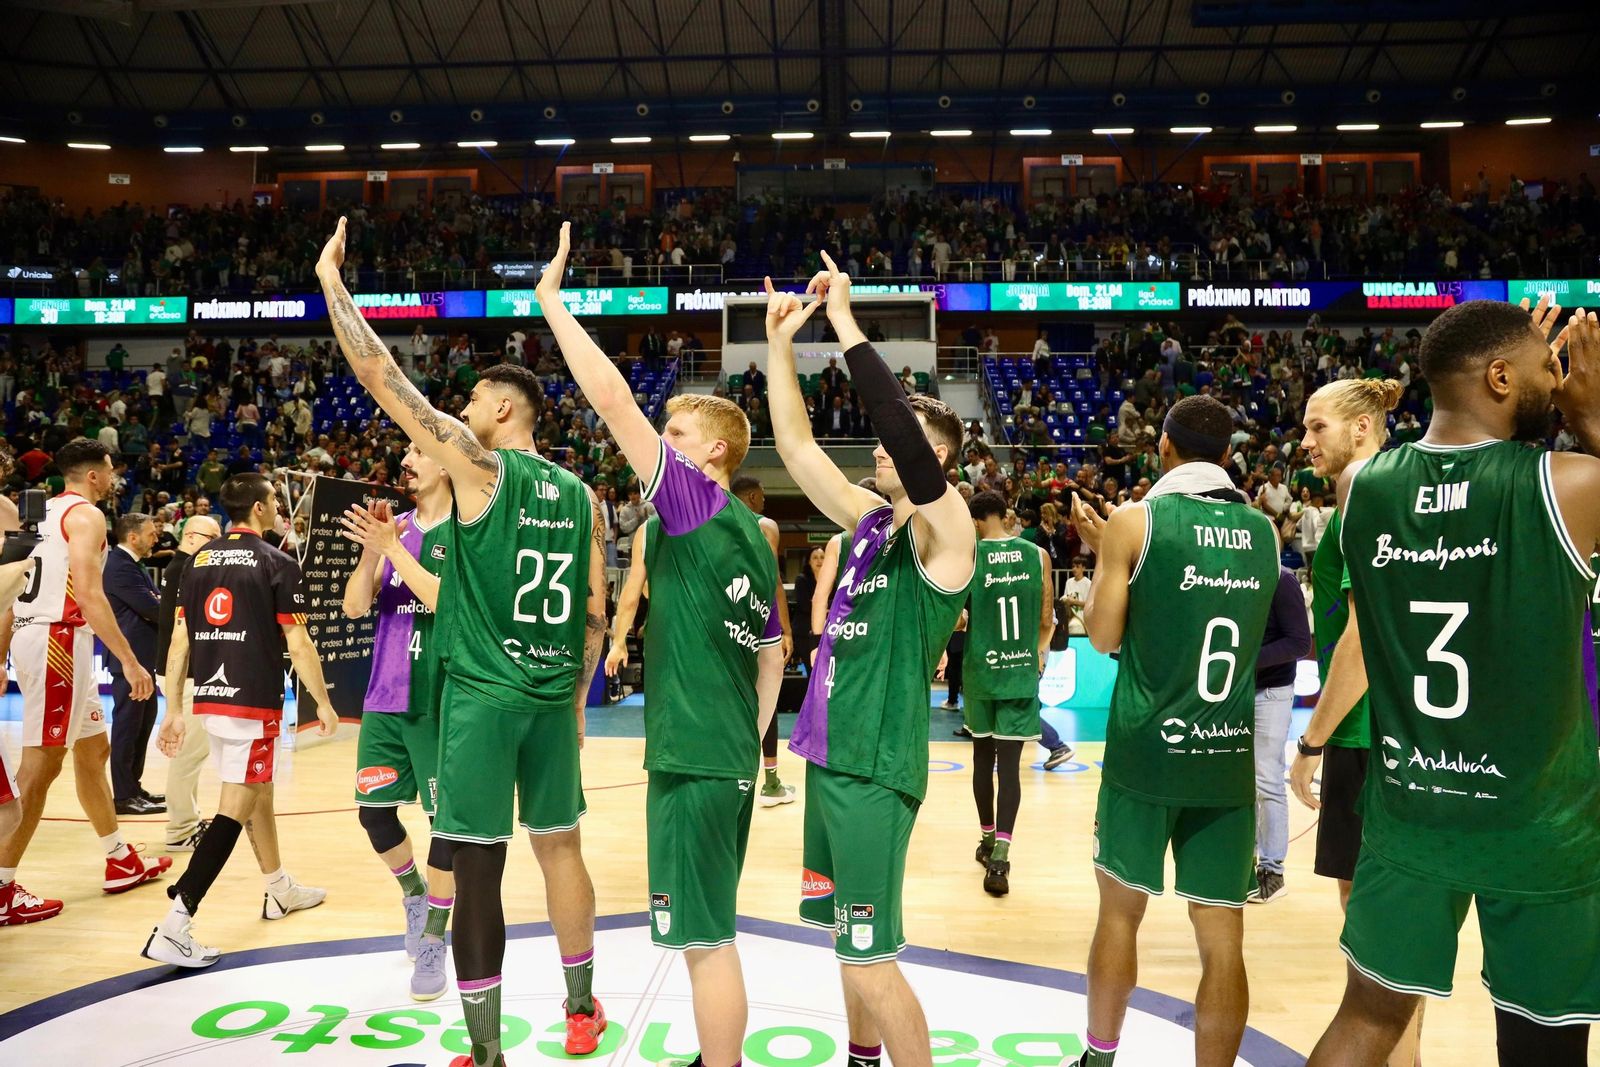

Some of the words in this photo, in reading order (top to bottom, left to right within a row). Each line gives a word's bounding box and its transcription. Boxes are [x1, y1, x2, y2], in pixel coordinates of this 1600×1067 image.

[1006, 284, 1050, 296] JORNADA
[1095, 284, 1122, 297] 21.04
[1188, 284, 1251, 306] PRÓXIMO
[1254, 288, 1310, 306] PARTIDO
[1363, 282, 1437, 296] UNICAJA
[1437, 281, 1462, 296] VS
[1524, 281, 1569, 294] JORNADA
[30, 300, 70, 312] JORNADA
[353, 293, 422, 307] UNICAJA
[421, 292, 445, 306] VS
[1019, 294, 1037, 310] 30
[1367, 295, 1456, 308] BASKONIA
[194, 298, 251, 319] PRÓXIMO
[253, 300, 305, 318] PARTIDO
[358, 306, 438, 318] ASKONIA
[513, 300, 530, 316] 30
[1415, 481, 1470, 514] EJIM
[312, 528, 333, 536] endesa
[1194, 525, 1252, 550] TAYLOR
[209, 558, 221, 566] DE
[326, 557, 347, 565] endesa
[988, 550, 1022, 564] CARTER
[306, 570, 328, 578] endesa
[513, 548, 574, 625] 23
[997, 596, 1019, 641] 11
[321, 639, 342, 648] endesa
[340, 651, 360, 660] endesa
[1197, 617, 1240, 703] 6
[1410, 601, 1469, 719] 3
[1190, 720, 1251, 740] Andalucía
[1408, 746, 1506, 778] Andalucía
